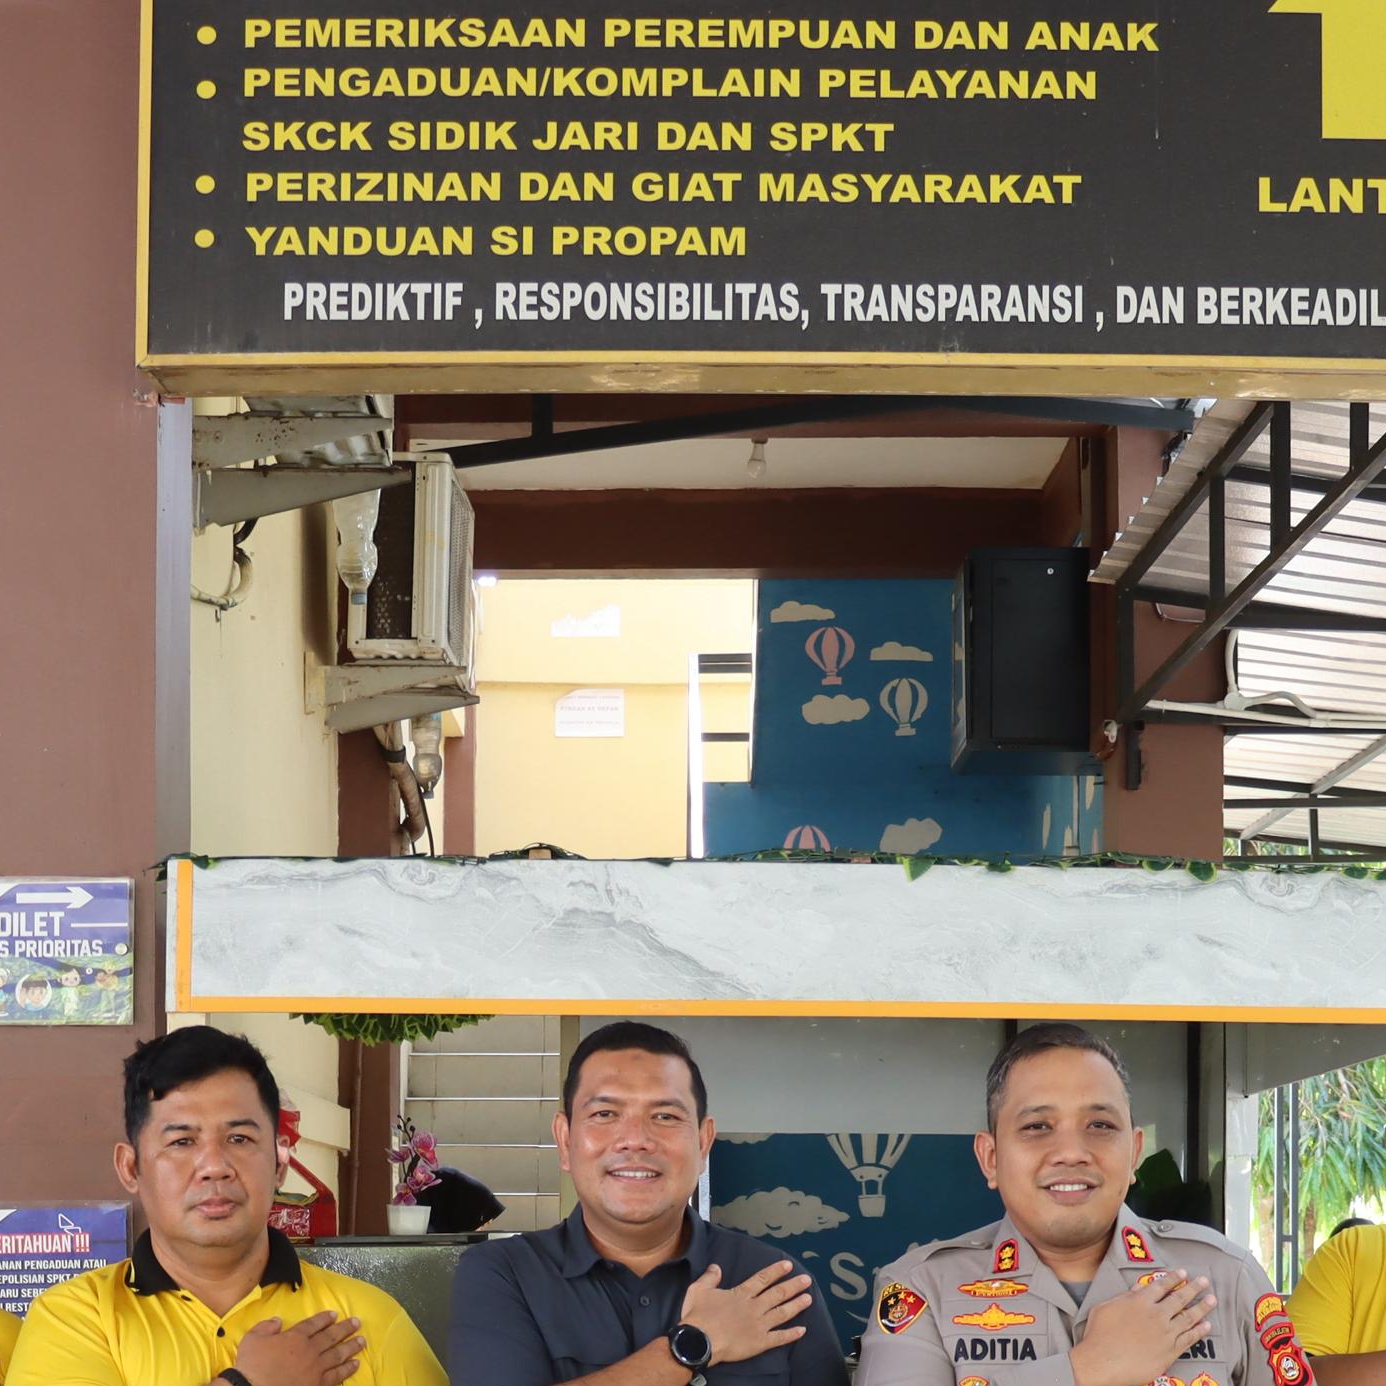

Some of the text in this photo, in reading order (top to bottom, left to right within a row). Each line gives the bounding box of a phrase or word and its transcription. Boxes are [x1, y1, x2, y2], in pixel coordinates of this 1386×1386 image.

[244, 19, 1159, 52] PEMERIKSAAN PEREMPUAN DAN ANAK
[244, 68, 1096, 99] PENGADUAN/KOMPLAIN PELAYANAN
[242, 121, 894, 153] SKCK SIDIK JARI DAN SPKT
[246, 172, 1082, 204] PERIZINAN DAN GIAT MASYARAKAT
[246, 226, 746, 257] YANDUAN SI PROPAM
[284, 282, 462, 321] PREDIKTIF
[494, 282, 810, 330] RESPONSIBILITAS,
[820, 283, 1082, 323] TRANSPARANSI
[1116, 286, 1184, 324] DAN
[15, 940, 103, 958] PRIORITAS
[75, 1234, 90, 1252] !!!
[24, 1259, 81, 1270] PENGADUAN
[954, 1337, 1037, 1363] ADITIA
